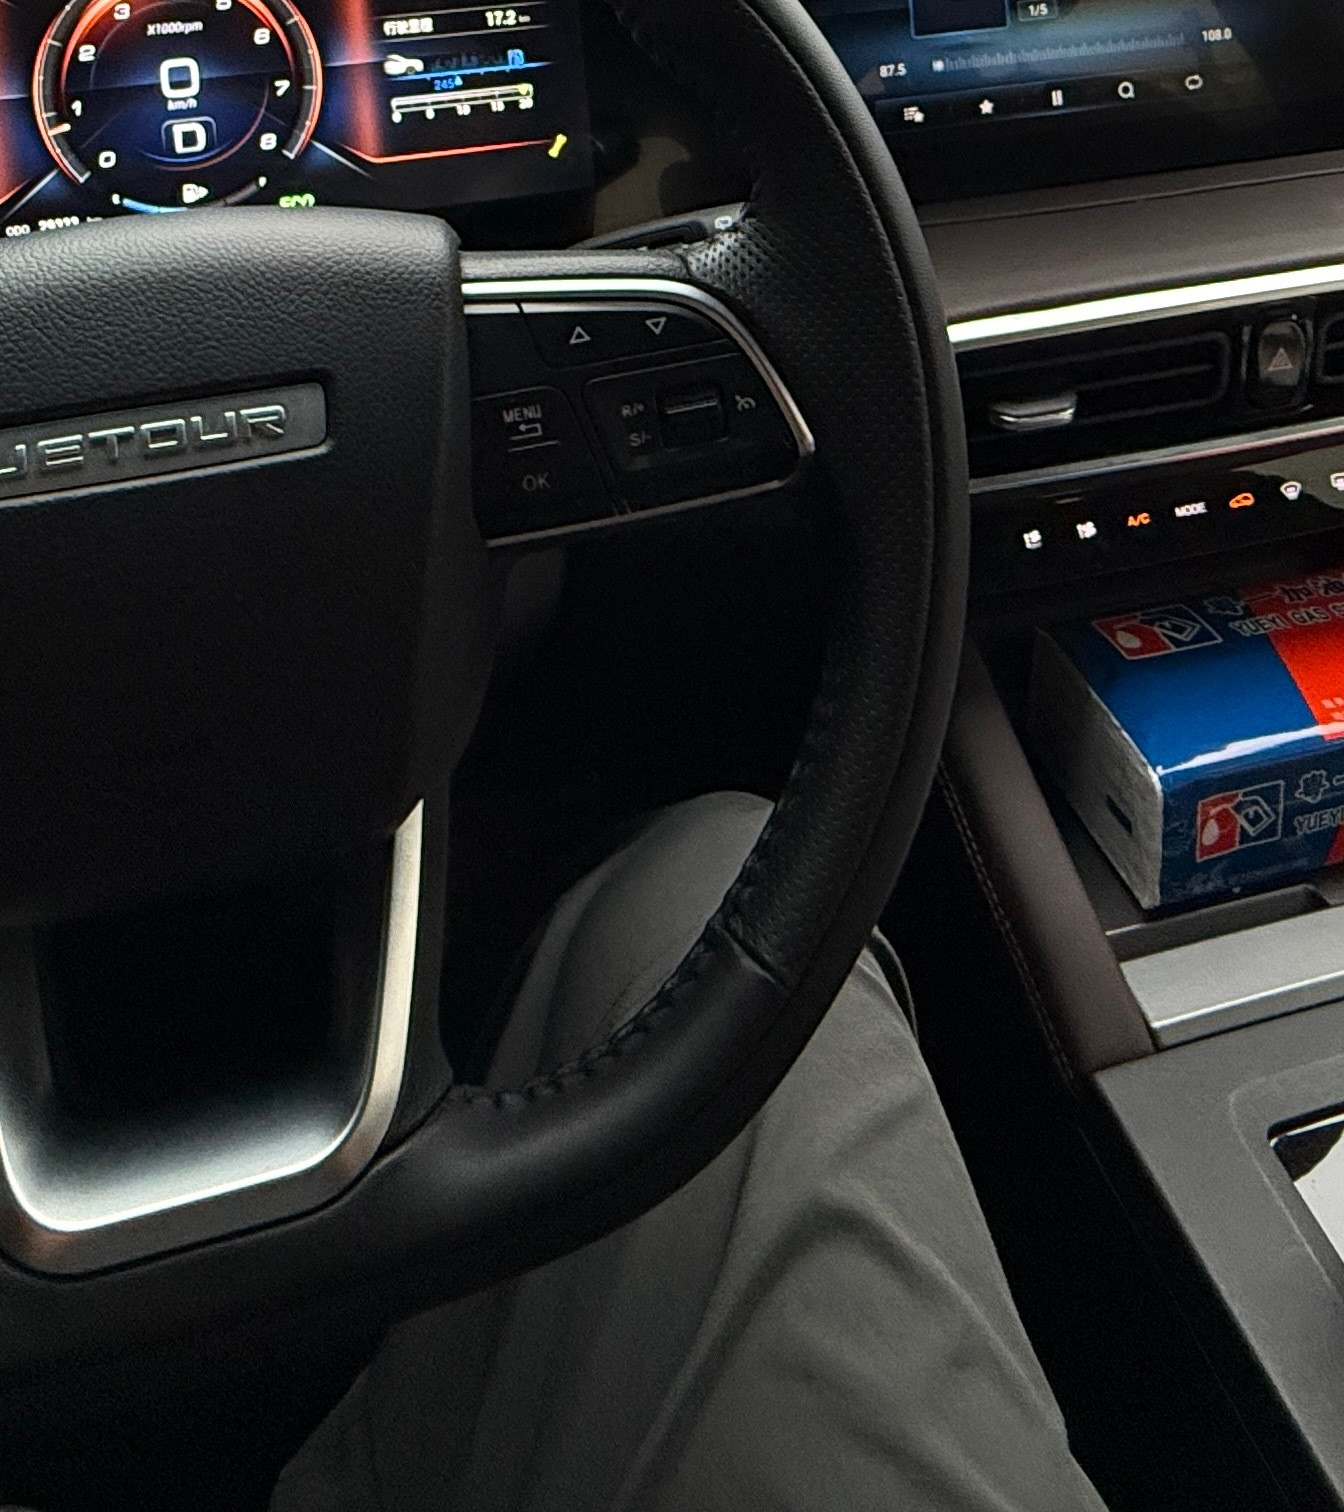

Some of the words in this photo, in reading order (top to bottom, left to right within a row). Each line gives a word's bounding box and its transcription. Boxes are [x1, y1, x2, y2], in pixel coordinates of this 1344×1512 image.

[112, 3, 130, 20] 3
[484, 8, 517, 27] 17.2
[1027, 2, 1049, 17] 1/5
[253, 27, 271, 46] 6
[1201, 27, 1233, 42] 108.0
[77, 44, 96, 62] 2
[159, 57, 200, 99] 0
[879, 63, 906, 78] 87.5
[274, 79, 291, 97] 7
[70, 99, 82, 117] 1
[172, 122, 207, 155] D
[259, 132, 278, 151] 8
[98, 150, 117, 169] 0
[503, 404, 542, 423] MENU
[522, 472, 550, 492] OK
[1127, 512, 1151, 527] A/C
[1174, 501, 1208, 518] MODE
[1230, 613, 1291, 636] YUEYI
[1287, 606, 1331, 625] GAS
